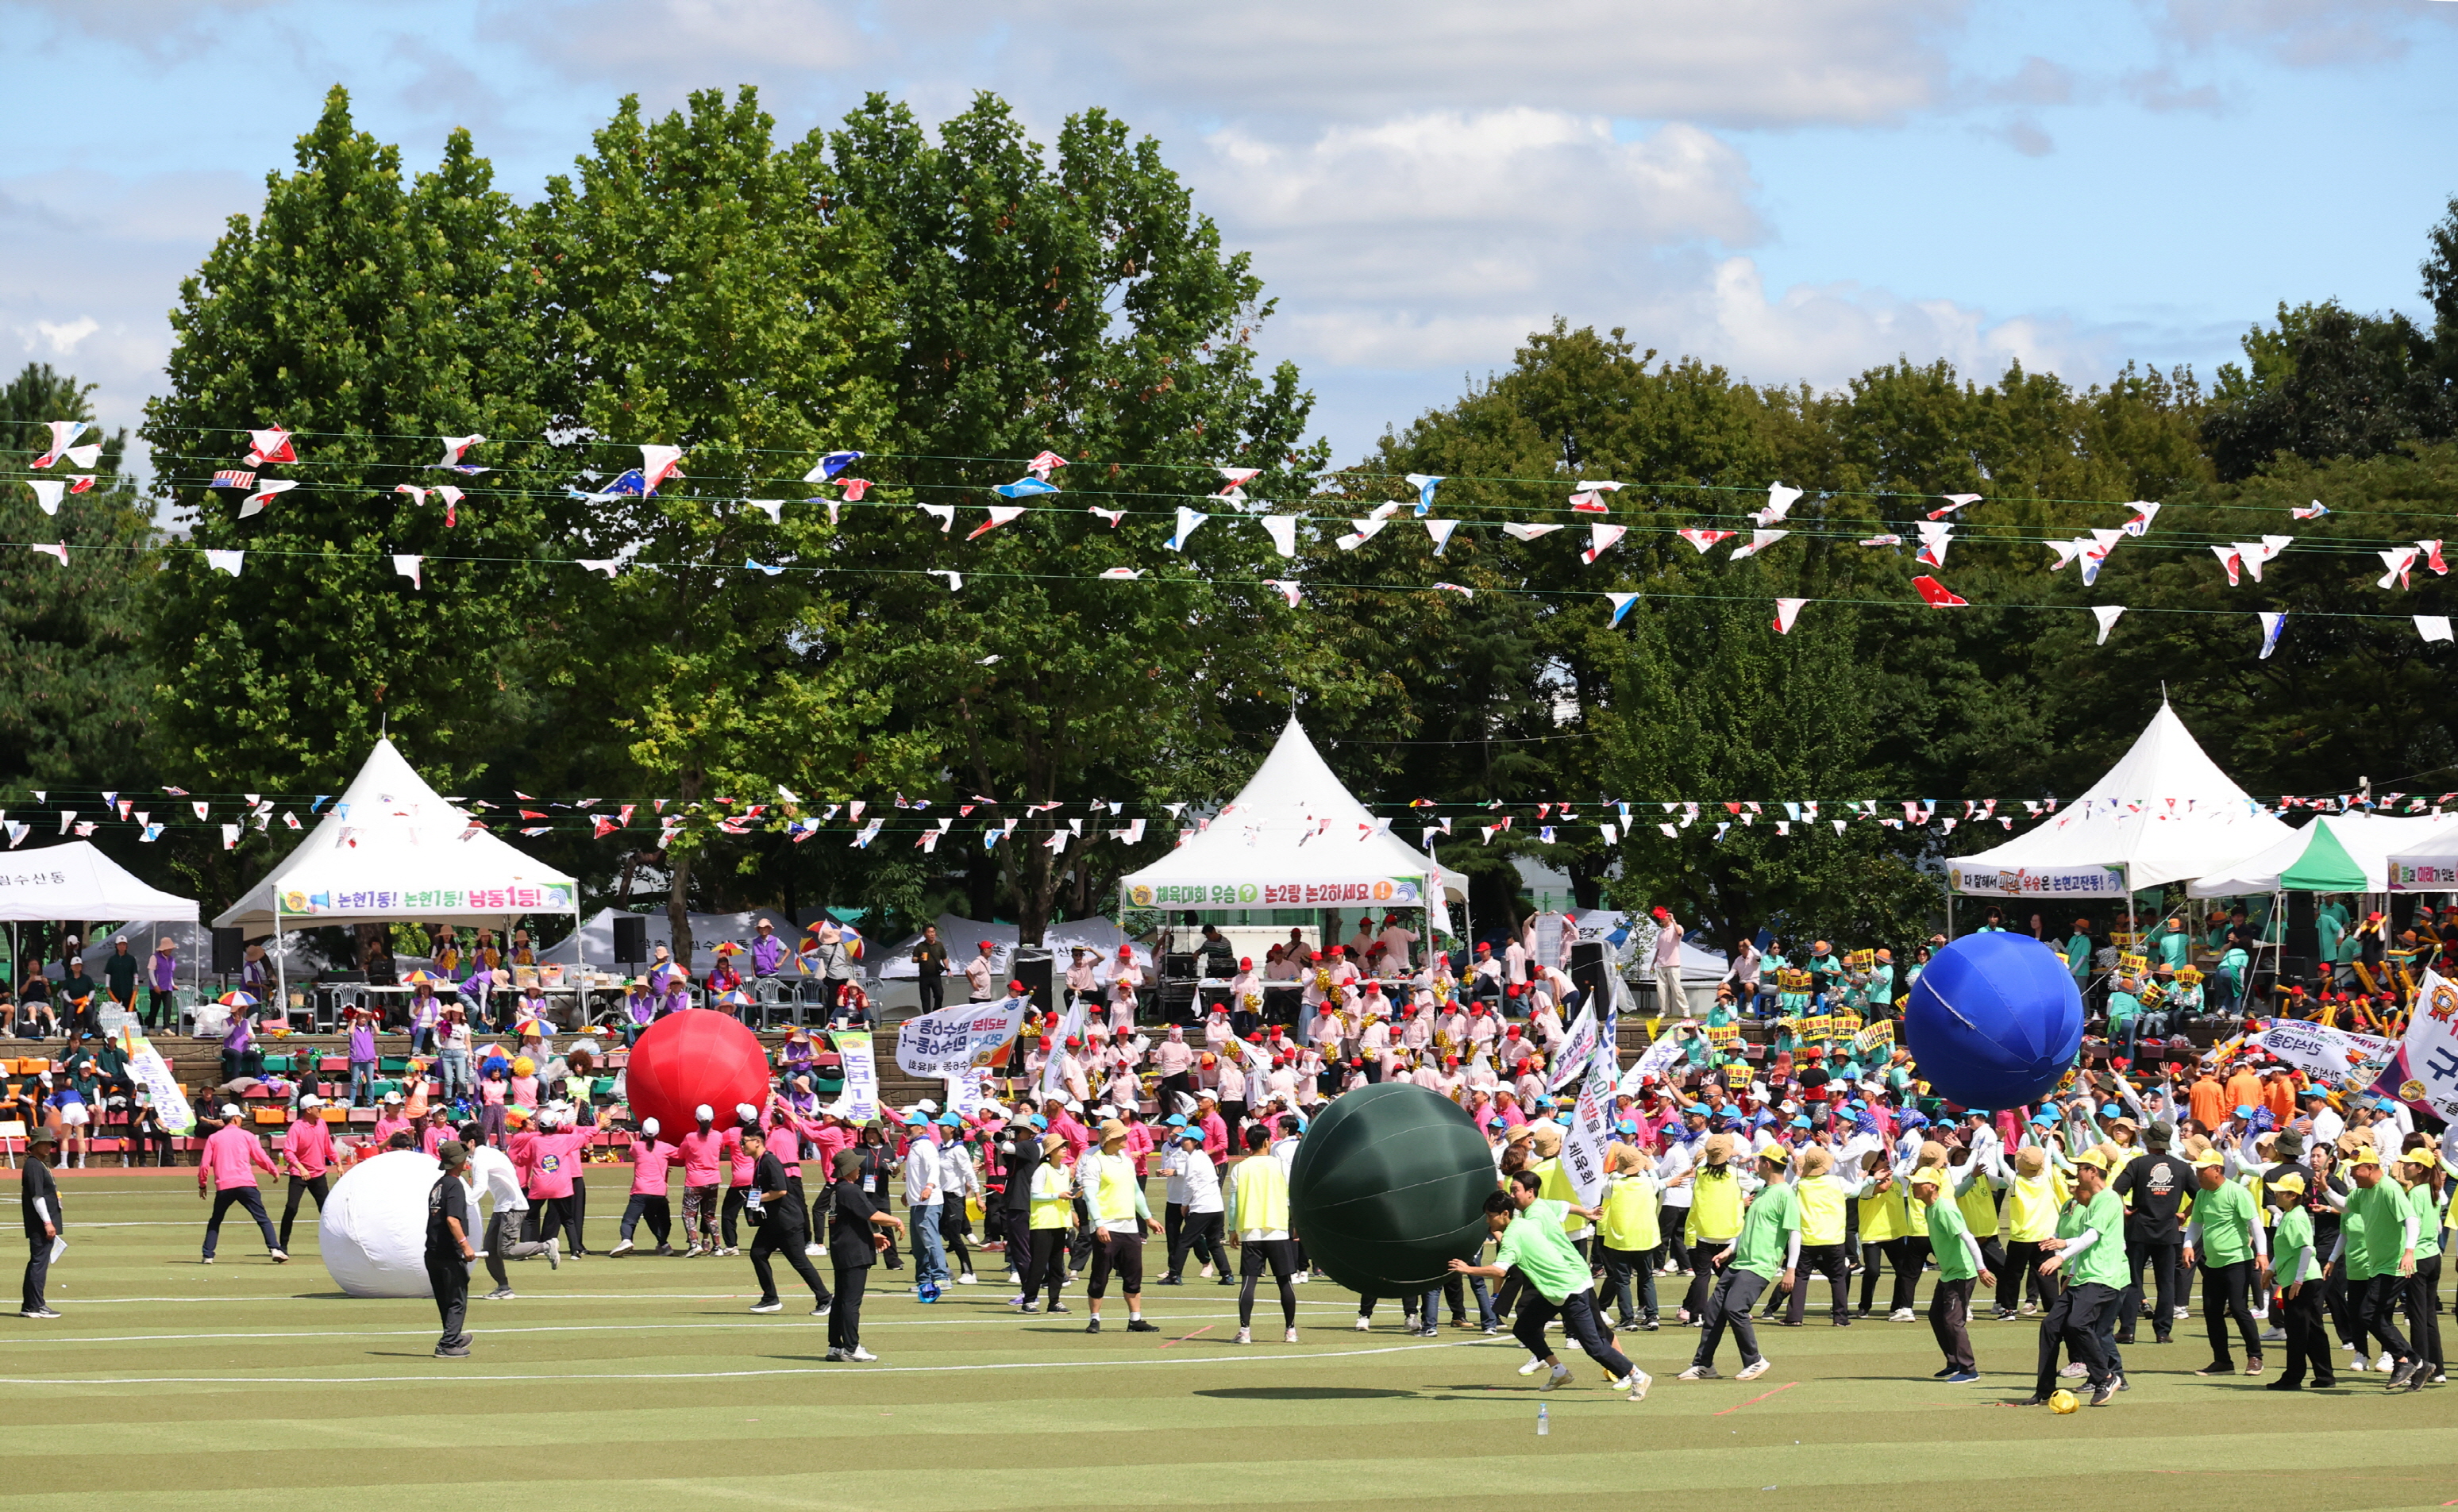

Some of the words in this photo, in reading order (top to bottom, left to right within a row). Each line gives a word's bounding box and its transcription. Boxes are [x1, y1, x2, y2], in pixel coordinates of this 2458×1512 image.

[1964, 874, 1972, 887] 다
[1974, 874, 1998, 888] 잘해서
[2023, 875, 2050, 891] 우승은
[2053, 875, 2104, 891] 논현고잔동!
[2402, 866, 2415, 883] 꿈과
[2418, 866, 2440, 883] 미래가
[2441, 868, 2455, 882] 있는
[337, 891, 398, 908] 논현1동!
[404, 890, 463, 907] 논현1등!
[468, 886, 541, 908] 남동1등!
[1156, 885, 1207, 904] 체육대회
[1211, 885, 1235, 904] 우승
[1265, 884, 1301, 903] 논2랑
[1305, 883, 1369, 903] 논2하세요
[1578, 1087, 1601, 1134] 깃발을
[1568, 1141, 1596, 1186] 체육회
